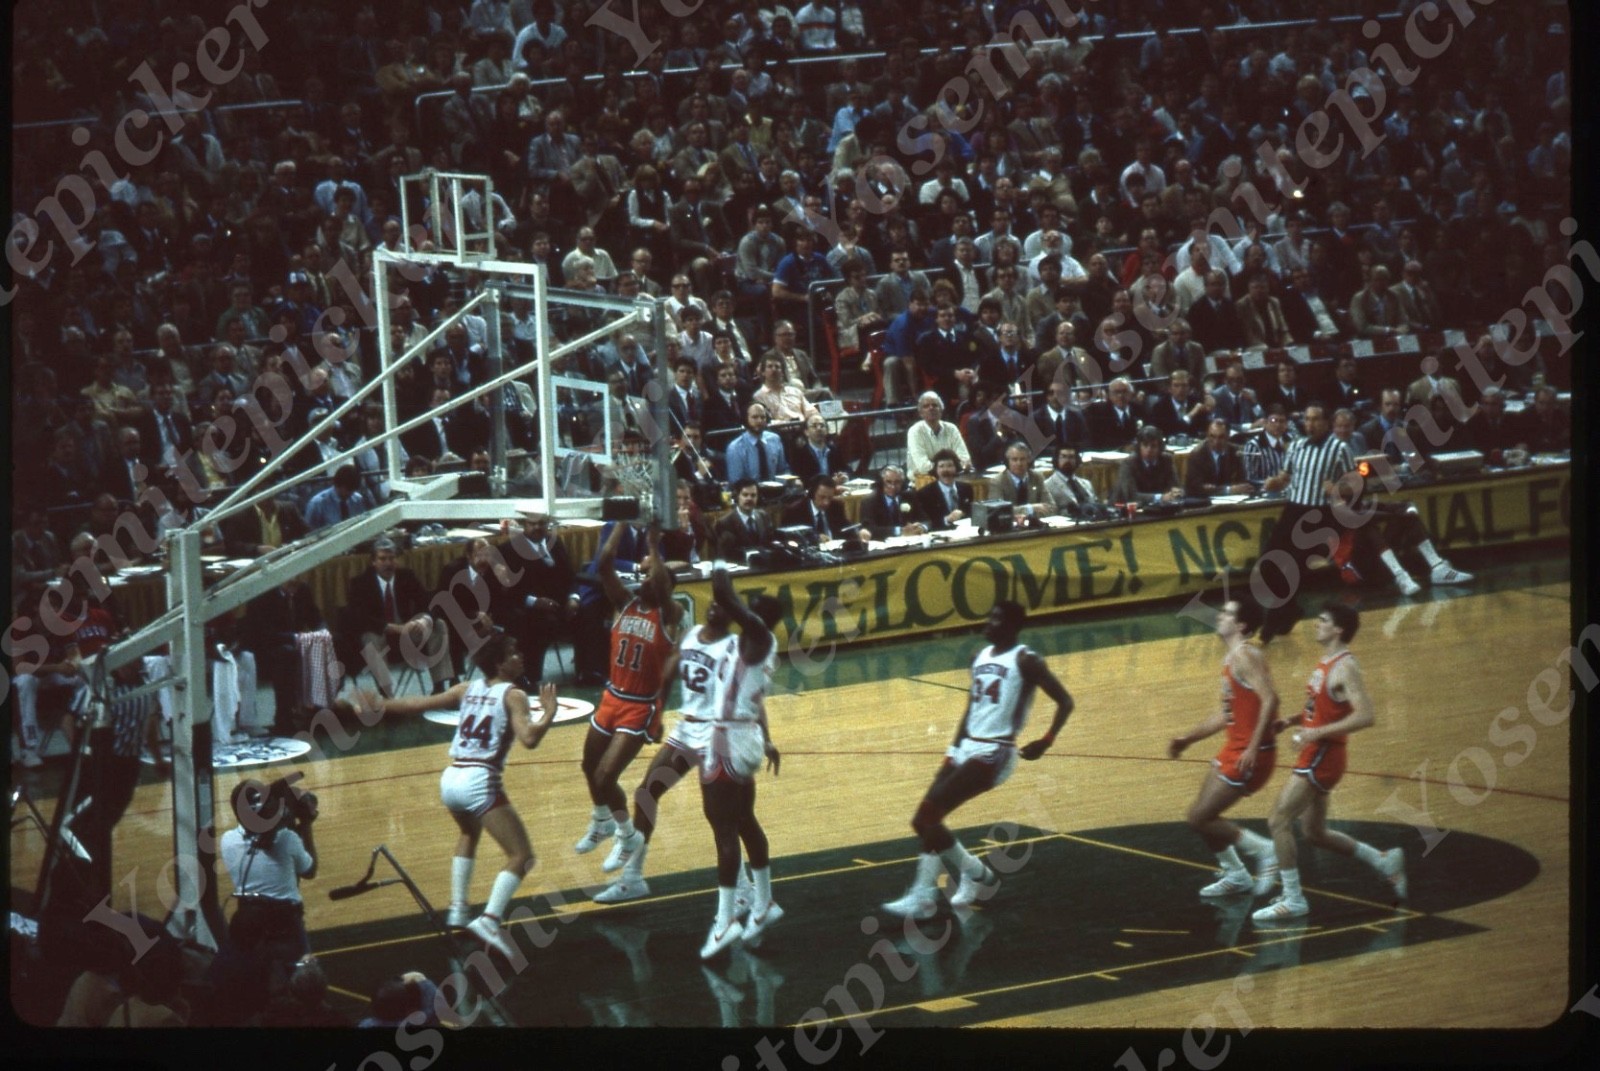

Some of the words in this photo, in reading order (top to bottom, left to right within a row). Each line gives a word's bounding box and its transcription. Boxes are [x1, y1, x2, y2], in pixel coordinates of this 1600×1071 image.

[740, 529, 1144, 644] WELCOME!
[615, 638, 644, 672] 11
[460, 714, 493, 749] 44
